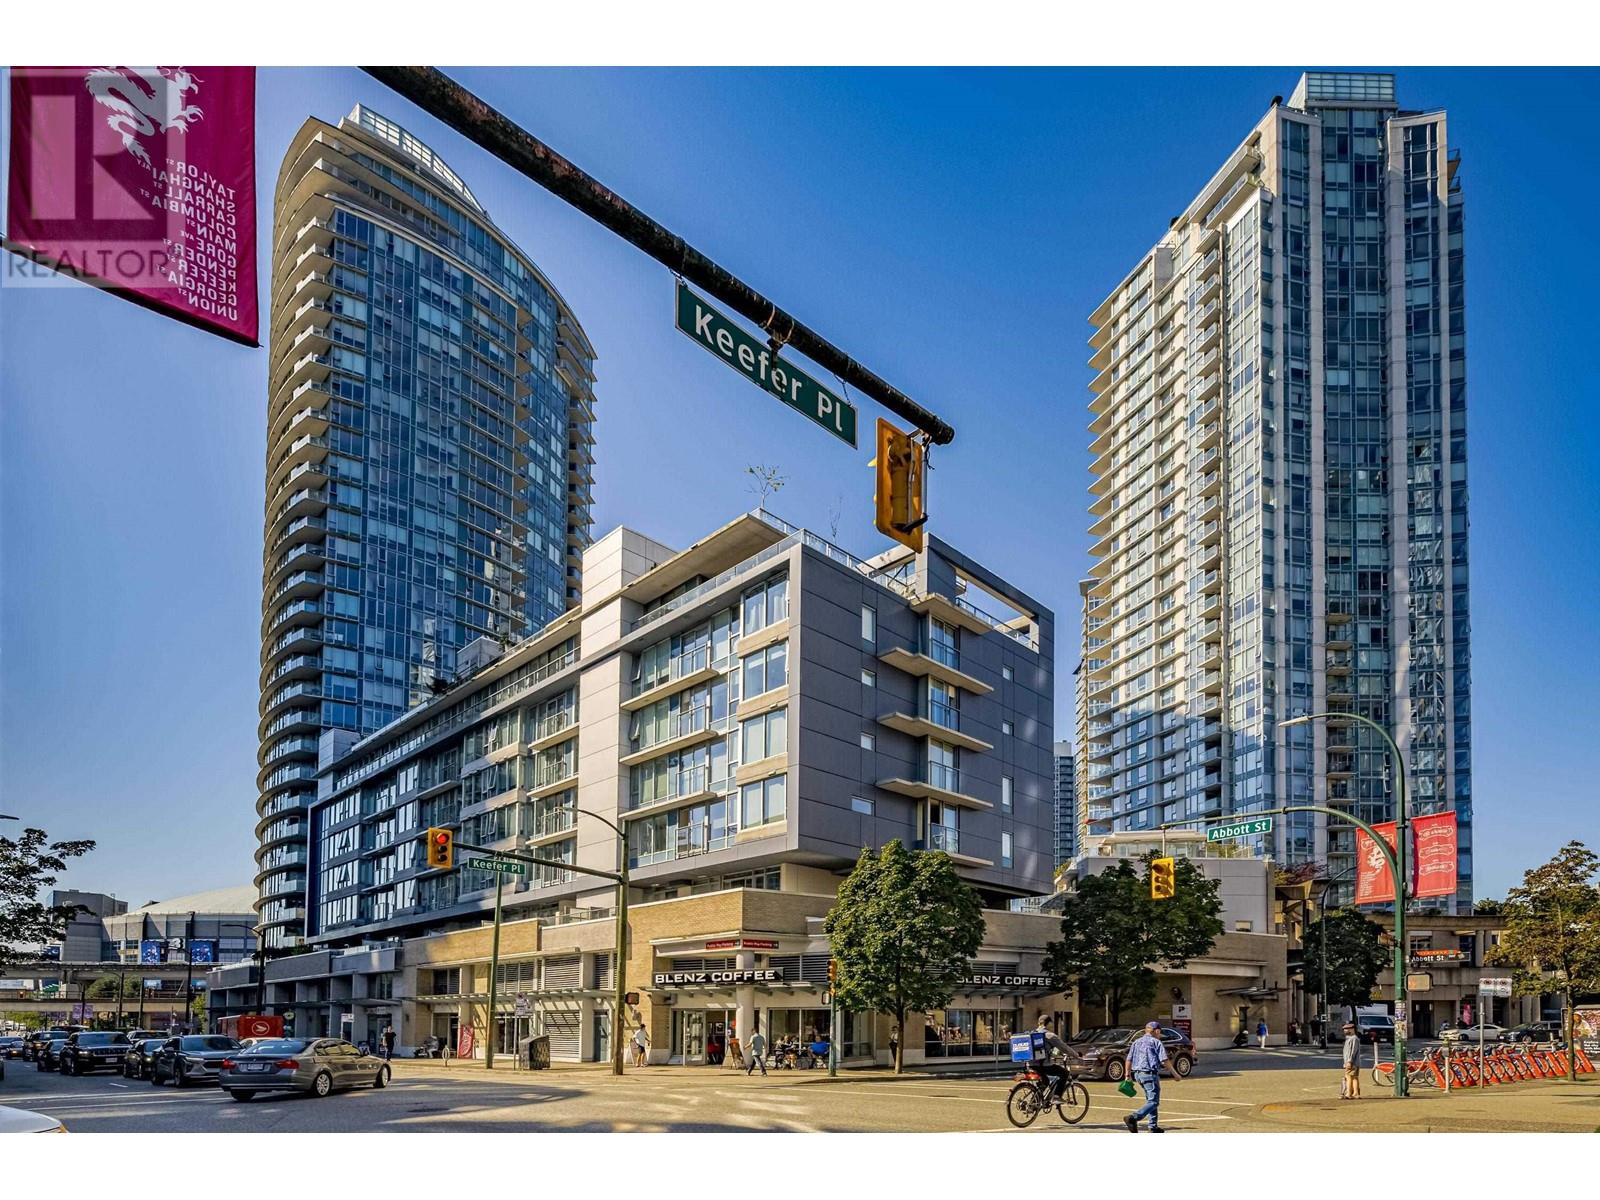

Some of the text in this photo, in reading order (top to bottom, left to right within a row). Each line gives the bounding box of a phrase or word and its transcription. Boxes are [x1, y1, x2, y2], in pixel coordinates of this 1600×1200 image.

[695, 304, 843, 432] Keefer Pl
[1212, 821, 1267, 839] Abbott St
[473, 859, 521, 873] Keefer Pl
[655, 970, 776, 983] BLENZ COFFEE
[1004, 976, 1053, 986] COFFEE
